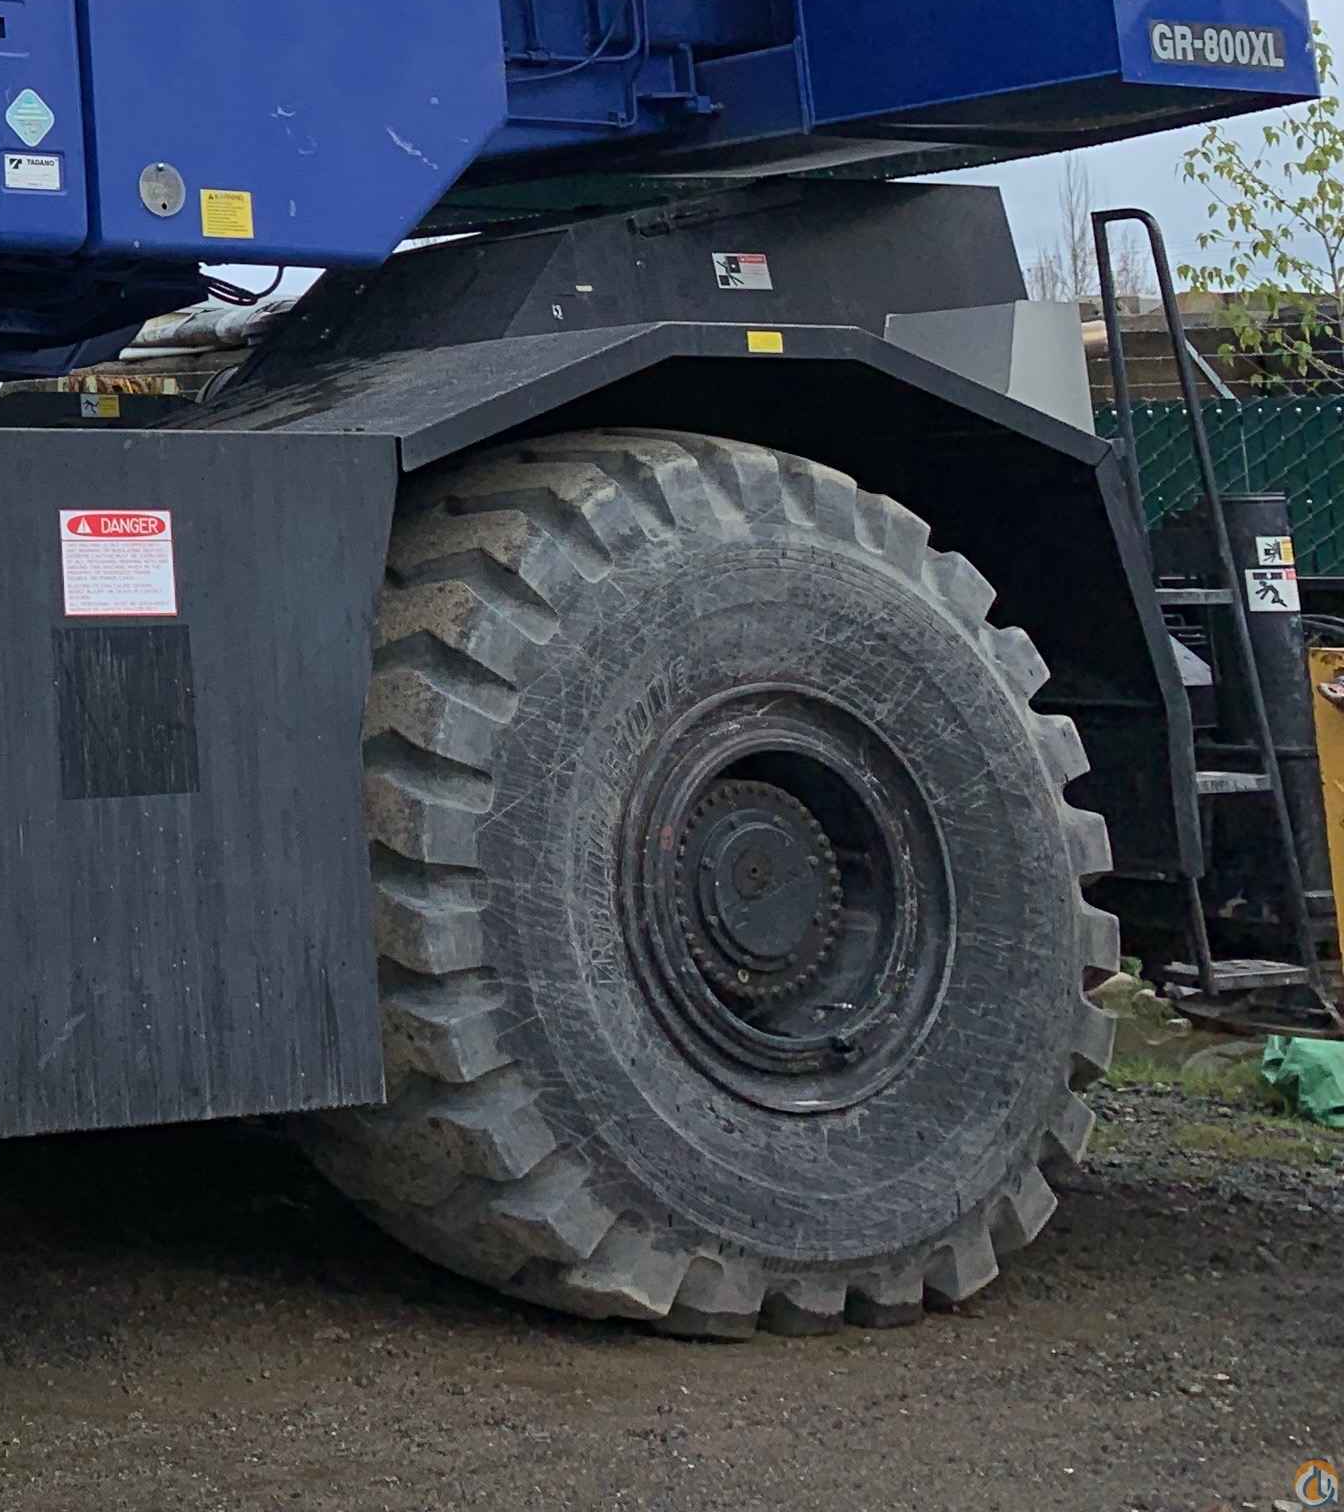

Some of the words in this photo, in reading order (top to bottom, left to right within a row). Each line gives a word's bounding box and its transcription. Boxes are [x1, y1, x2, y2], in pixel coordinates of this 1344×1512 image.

[1151, 22, 1285, 68] GR-800XL
[26, 158, 55, 167] TADANO
[100, 517, 160, 535] DANGER
